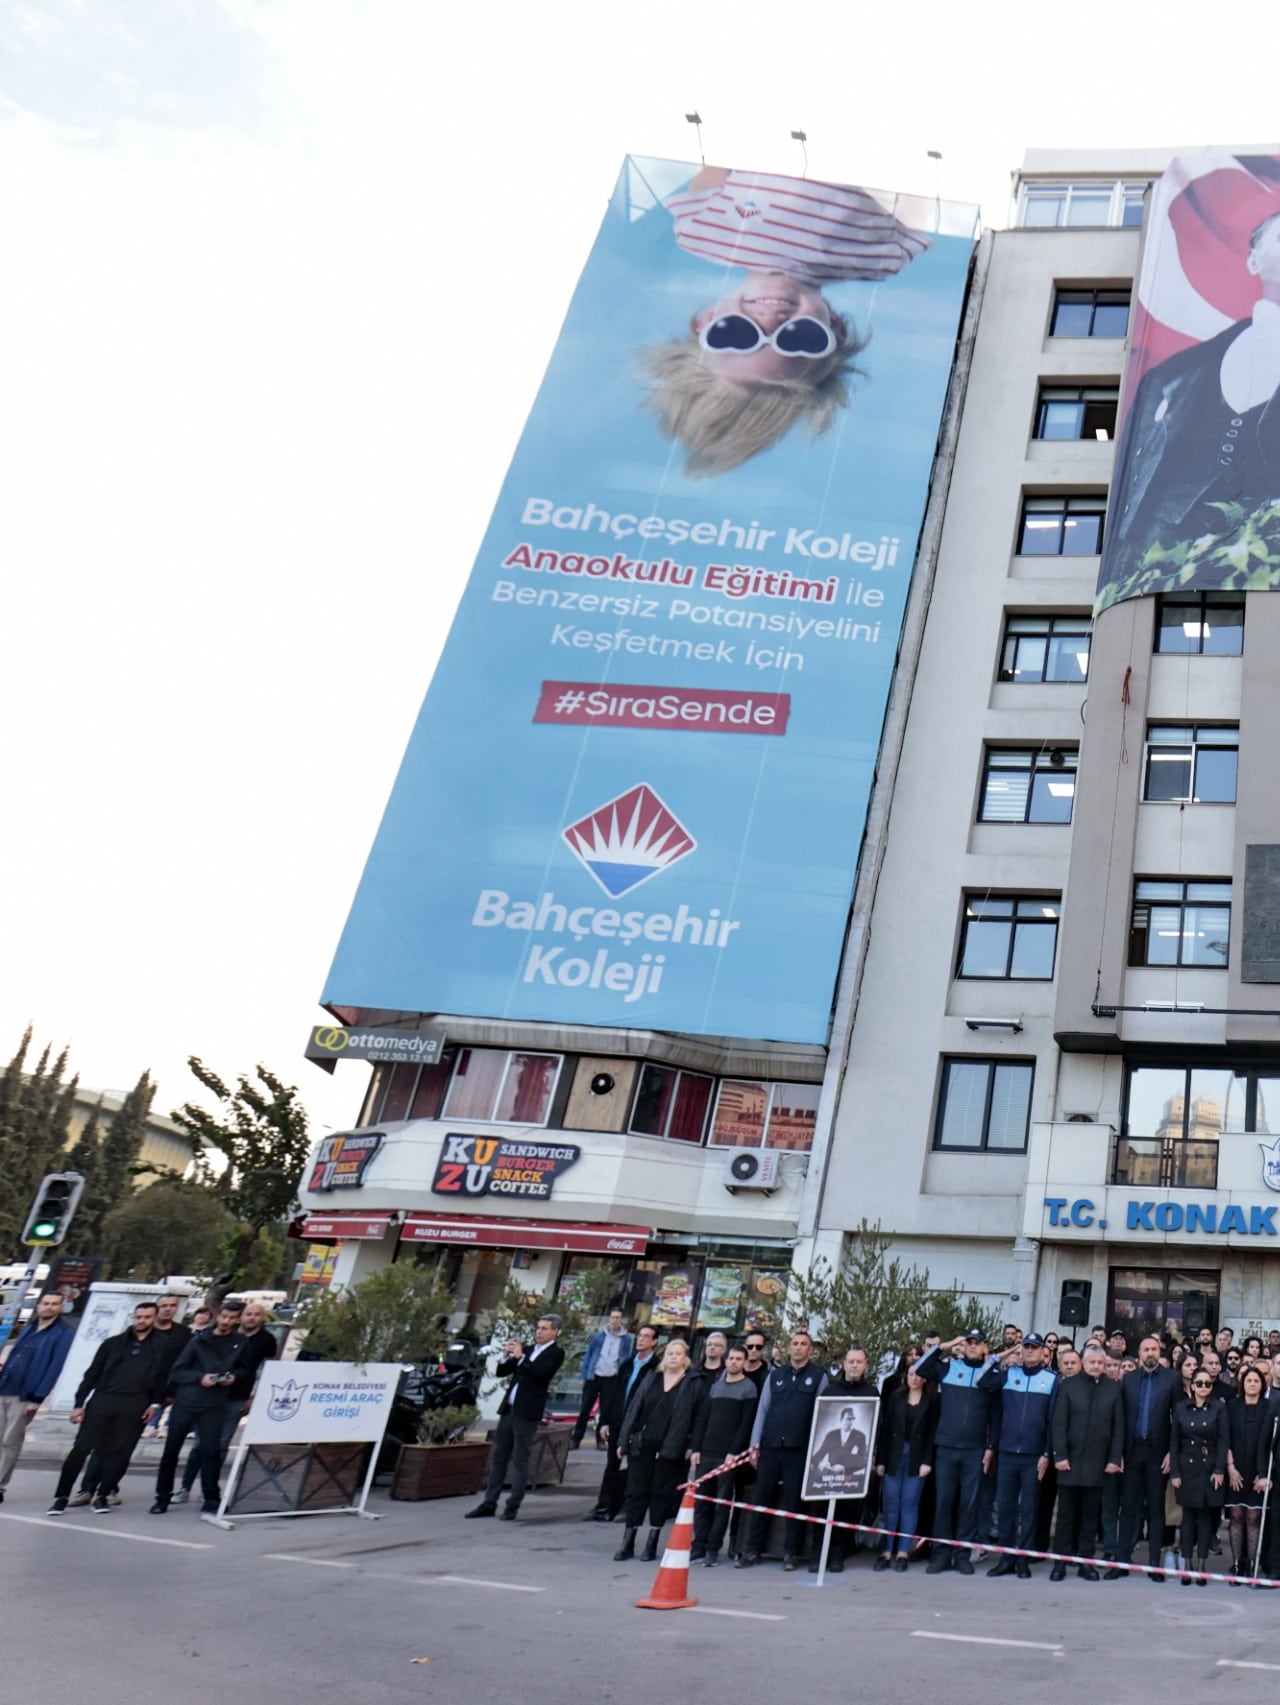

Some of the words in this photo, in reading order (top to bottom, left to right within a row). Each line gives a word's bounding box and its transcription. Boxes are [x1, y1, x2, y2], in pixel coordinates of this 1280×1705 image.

[521, 497, 775, 552] Bahçeşehir
[784, 527, 900, 572] Koleji
[504, 544, 693, 587] Anaokulu
[704, 566, 837, 603] Eğitimi
[492, 581, 660, 619] Benzersiz
[668, 600, 881, 644] Potansiyelini
[551, 624, 736, 665] Keşfetmek
[745, 640, 805, 671] İçin
[472, 889, 740, 948] Bahçeşehir
[523, 945, 667, 1003] Koleji
[348, 1034, 438, 1054] ottomedya
[500, 1144, 575, 1160] SANDWICH
[497, 1157, 556, 1172] BURGER
[493, 1168, 545, 1182] SNACK
[489, 1182, 549, 1195] COFFEE
[1043, 1197, 1108, 1229] T.C.
[1126, 1201, 1278, 1235] KONAK
[414, 1228, 439, 1238] KUZU
[440, 1229, 478, 1239] BURGER
[1241, 1328, 1269, 1338] İZMİR
[343, 1382, 387, 1391] BELEDİYESİ
[310, 1392, 348, 1403] RESMİ
[350, 1393, 384, 1405] ARAÇ
[323, 1405, 360, 1419] GİRİŞİ
